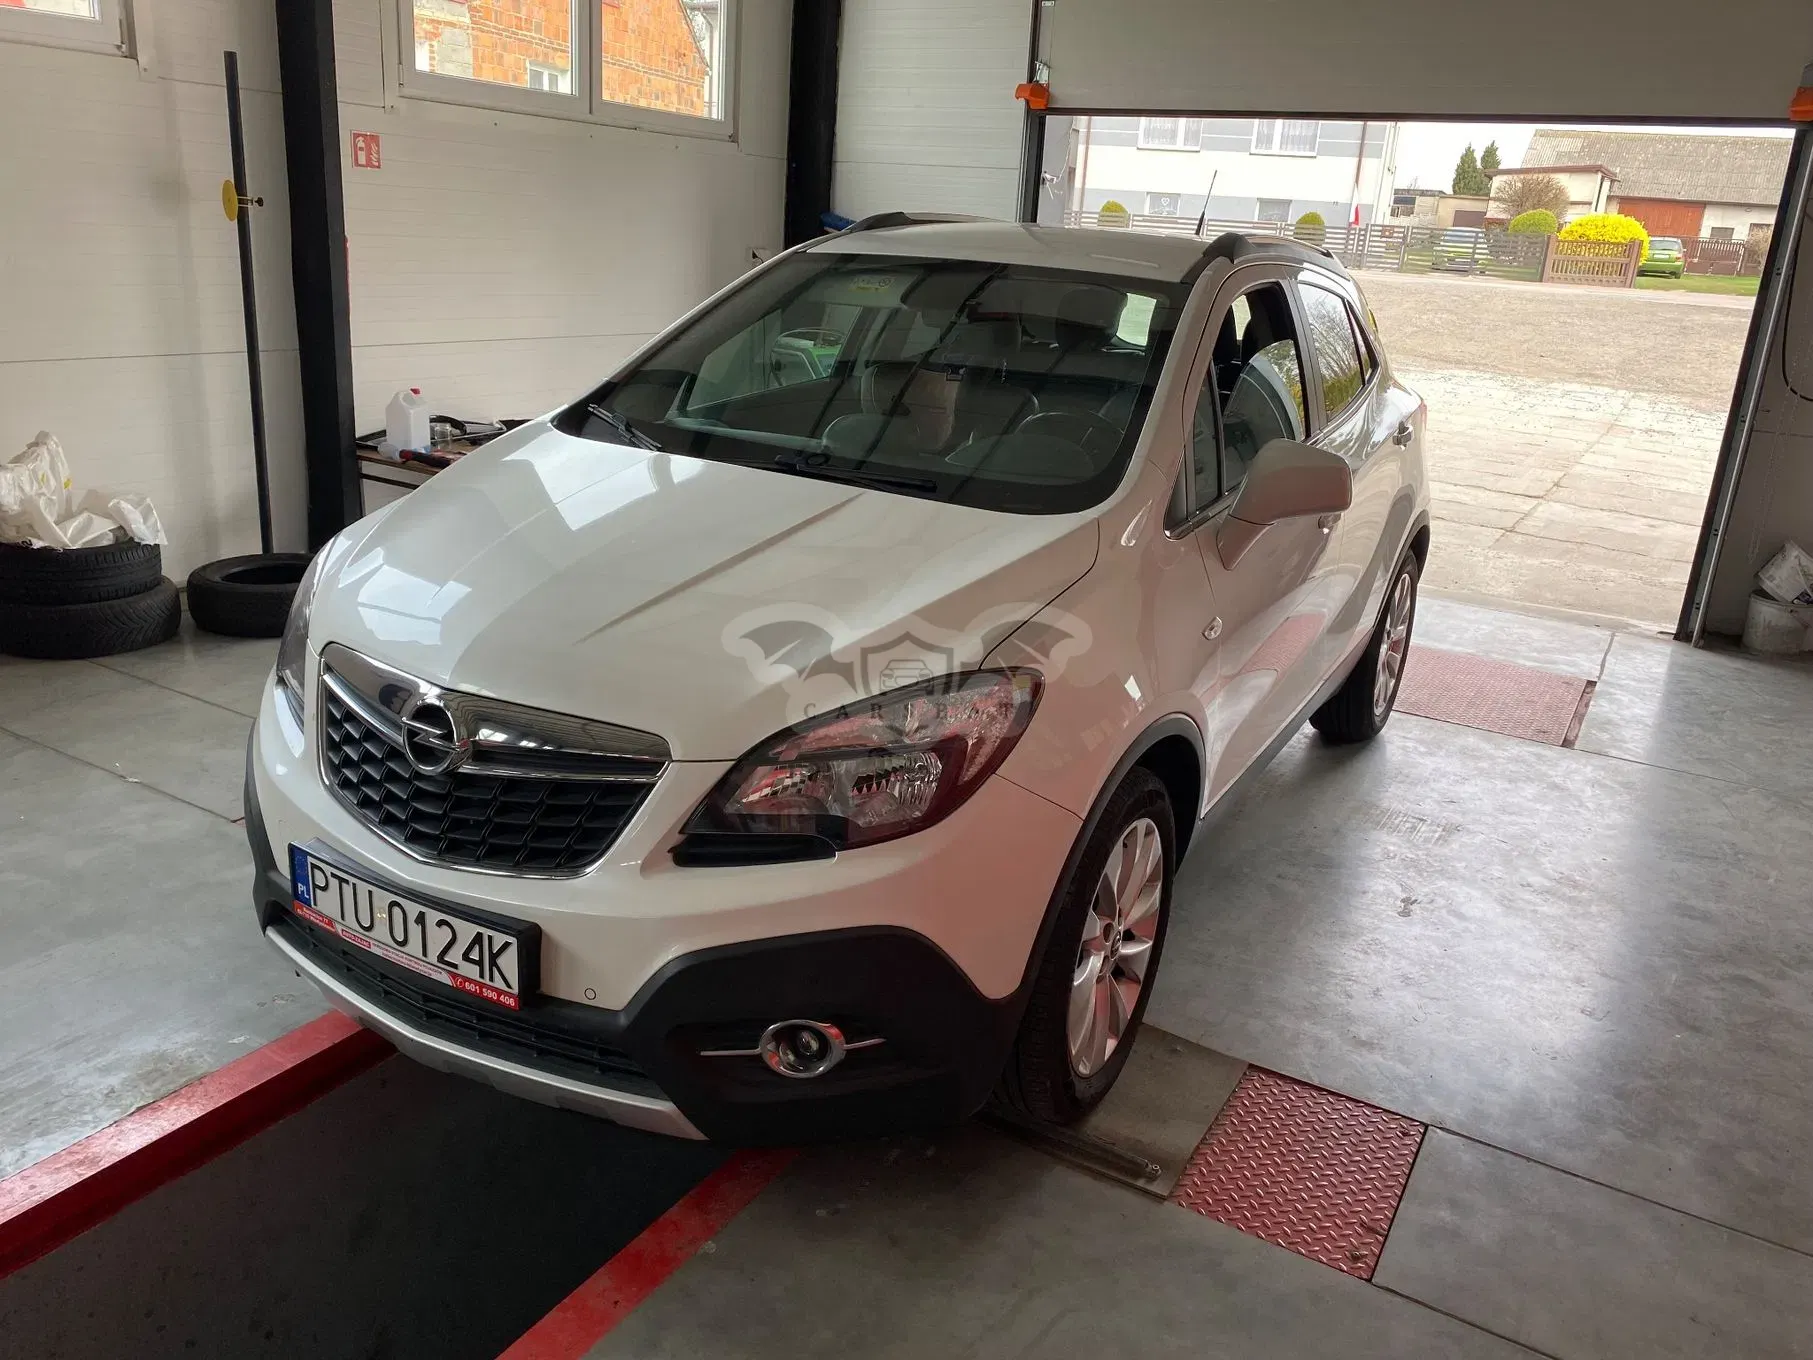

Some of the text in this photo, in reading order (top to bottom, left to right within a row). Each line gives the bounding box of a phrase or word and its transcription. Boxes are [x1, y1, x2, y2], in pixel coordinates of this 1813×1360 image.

[297, 882, 310, 899] PL
[310, 862, 514, 990] PTU 0124K
[465, 982, 480, 993] 601
[499, 994, 515, 1006] 406
